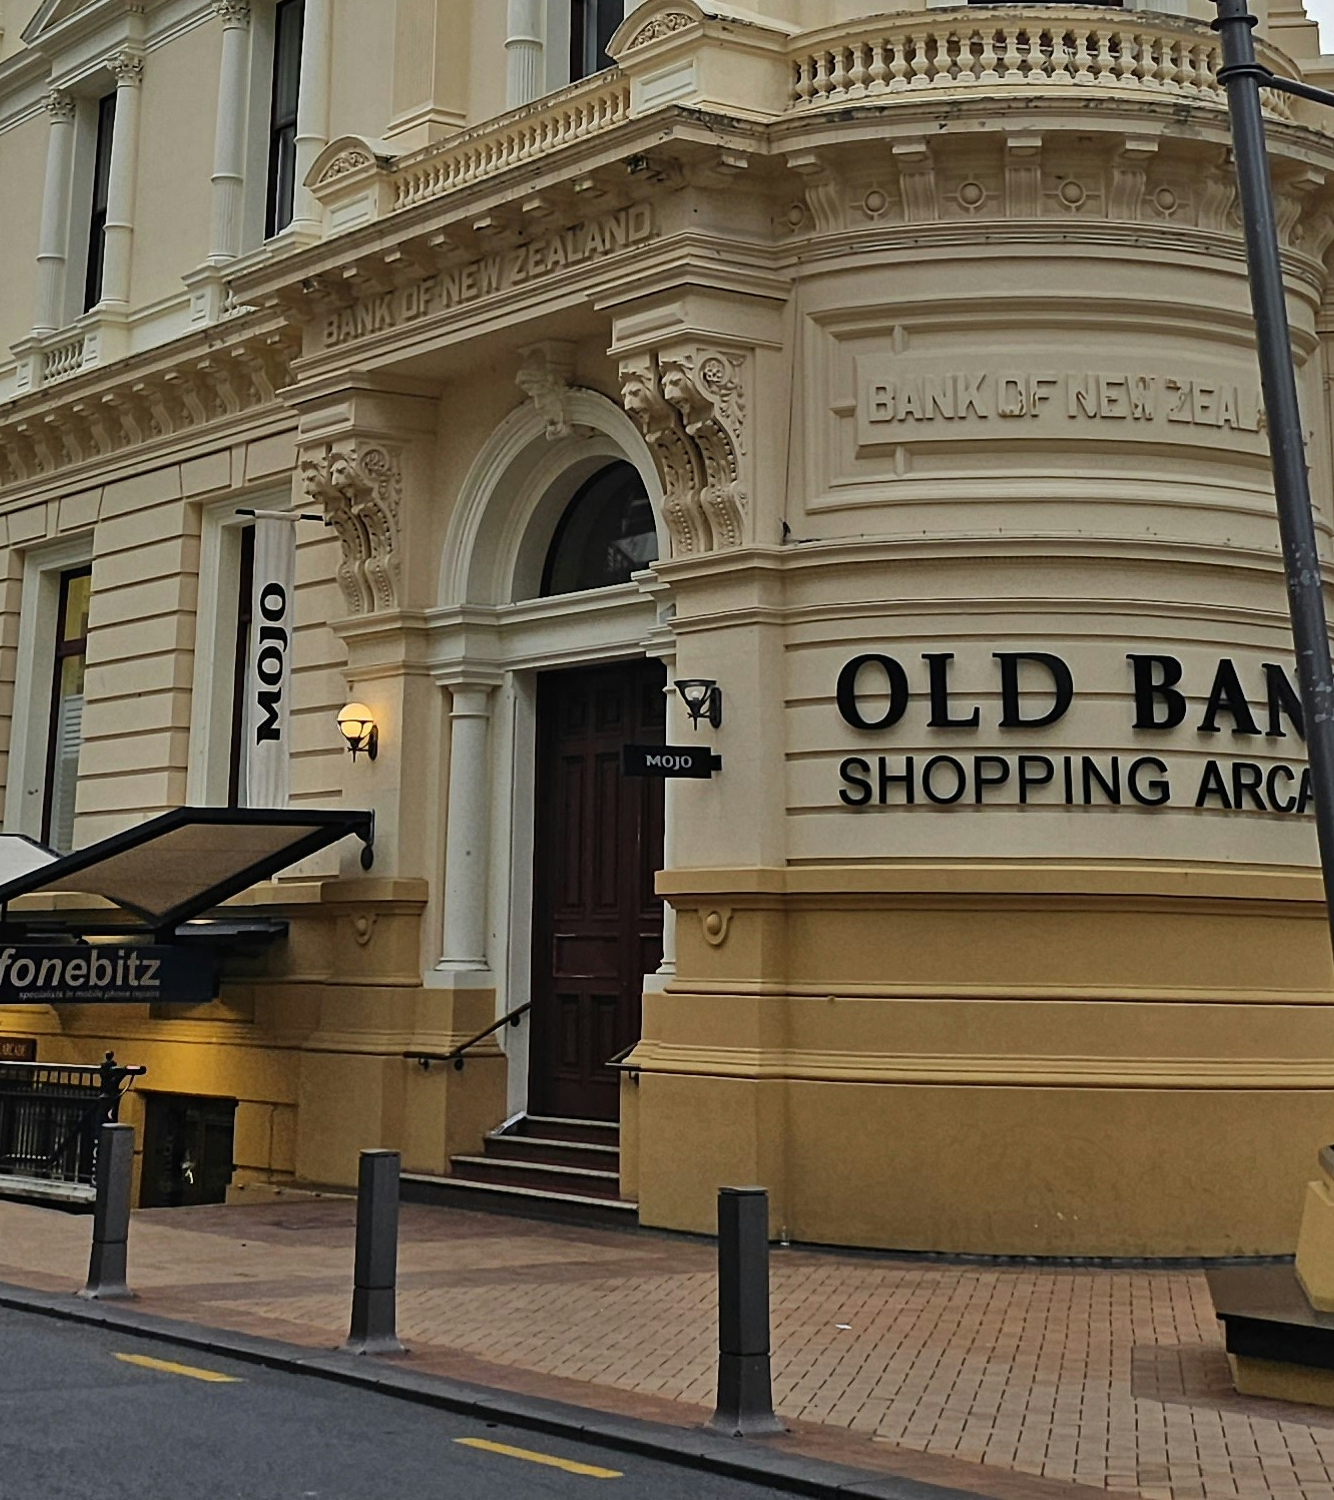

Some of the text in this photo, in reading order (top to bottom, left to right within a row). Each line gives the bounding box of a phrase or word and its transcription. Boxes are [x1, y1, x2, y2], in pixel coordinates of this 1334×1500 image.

[323, 202, 653, 347] BANK OF NEW ZEALAND
[868, 374, 988, 424] BANK
[998, 374, 1058, 419] OF
[1066, 373, 1157, 422] NEW
[256, 582, 289, 747] MOJO
[836, 652, 1074, 730] OLD
[645, 754, 693, 771] MOJO
[838, 754, 1171, 807] SHOPPING
[19, 989, 63, 1000] specialists
[75, 989, 103, 998] mobile
[104, 989, 131, 1000] phone
